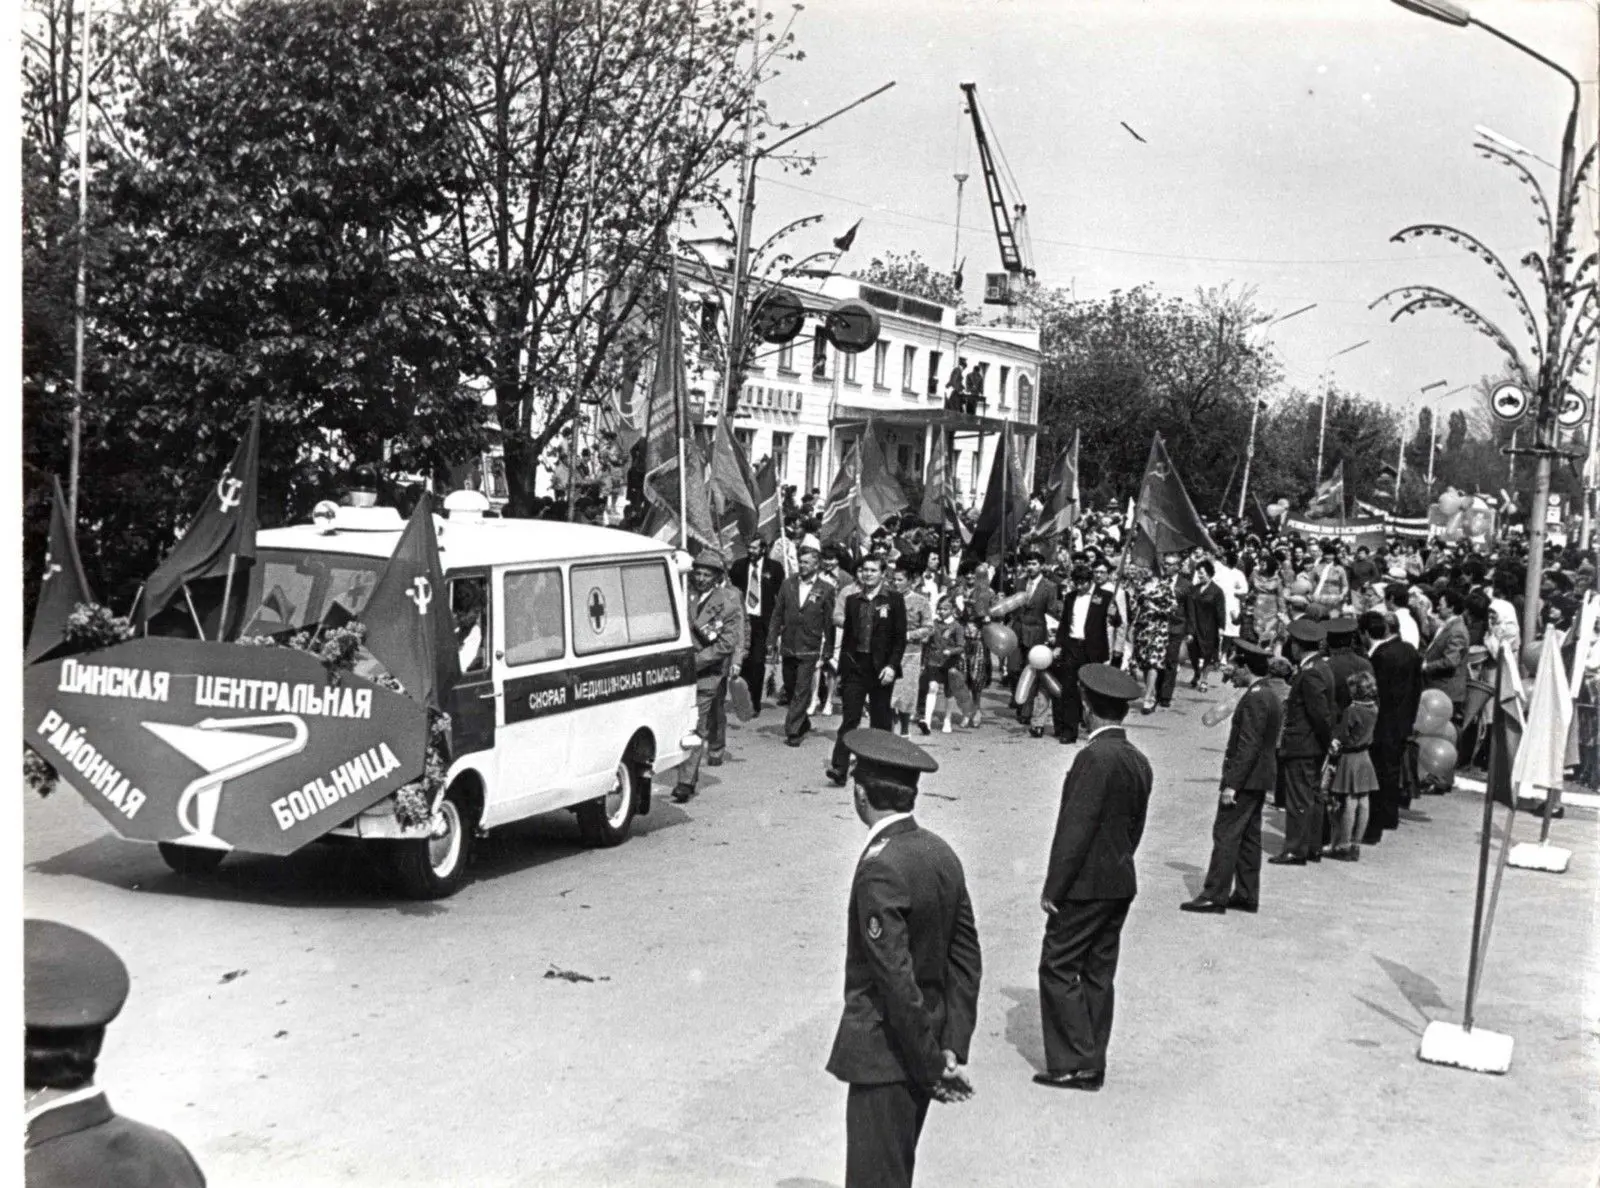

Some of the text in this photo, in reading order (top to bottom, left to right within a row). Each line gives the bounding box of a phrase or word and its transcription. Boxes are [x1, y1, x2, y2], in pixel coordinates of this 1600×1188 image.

[58, 658, 373, 719] ДИНСКАЯ ЦЕНТРАЛЬНАЯ
[529, 665, 681, 710] СКОРАЯ МЕДИЦИНСКАЯ ПОМОЩЬ
[37, 709, 147, 819] РАЙОННАЯ
[271, 743, 402, 831] БОЛЬНИЦА
